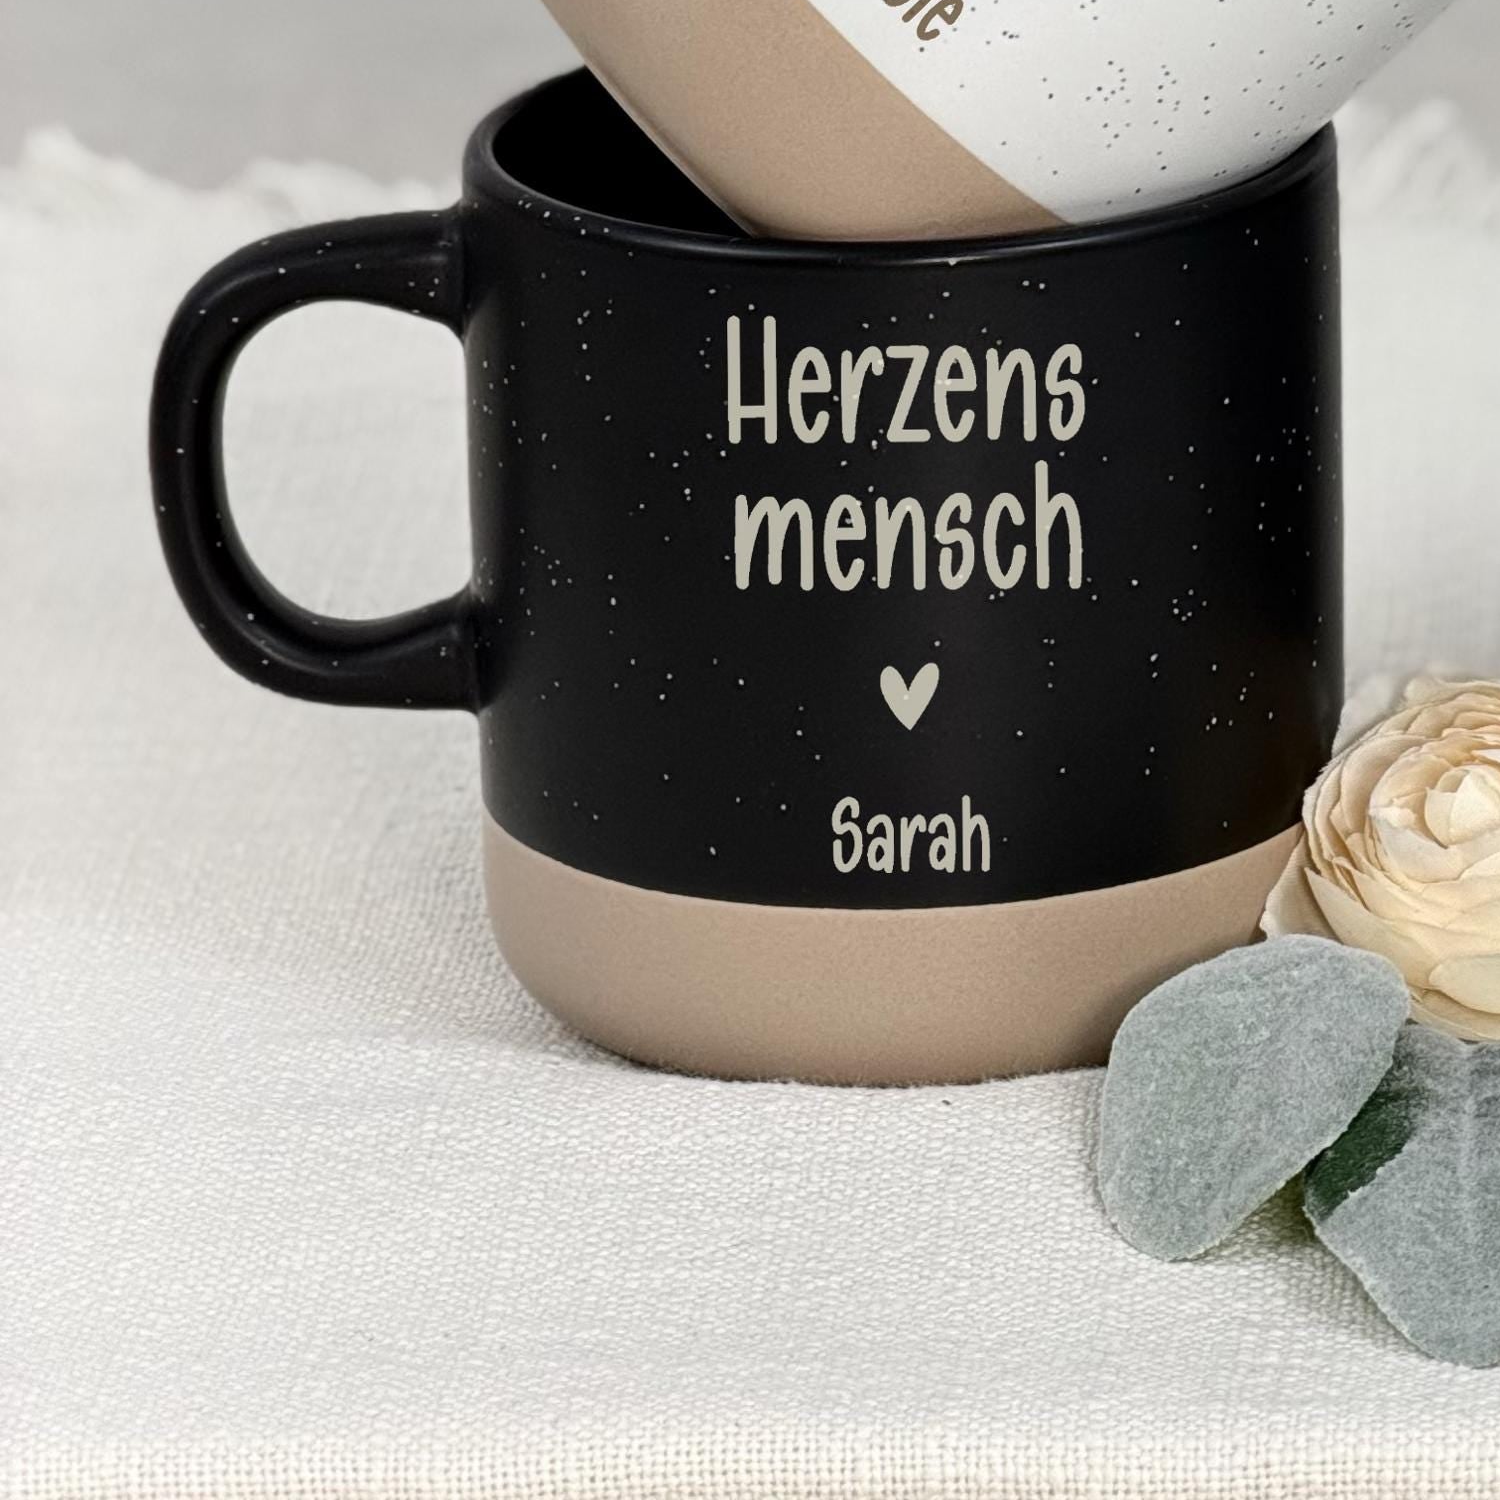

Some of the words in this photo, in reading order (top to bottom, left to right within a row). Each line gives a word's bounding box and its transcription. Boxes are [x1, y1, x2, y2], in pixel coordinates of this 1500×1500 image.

[726, 315, 1086, 444] Herzens
[734, 459, 1083, 591] mensch
[831, 795, 991, 874] Sarah
